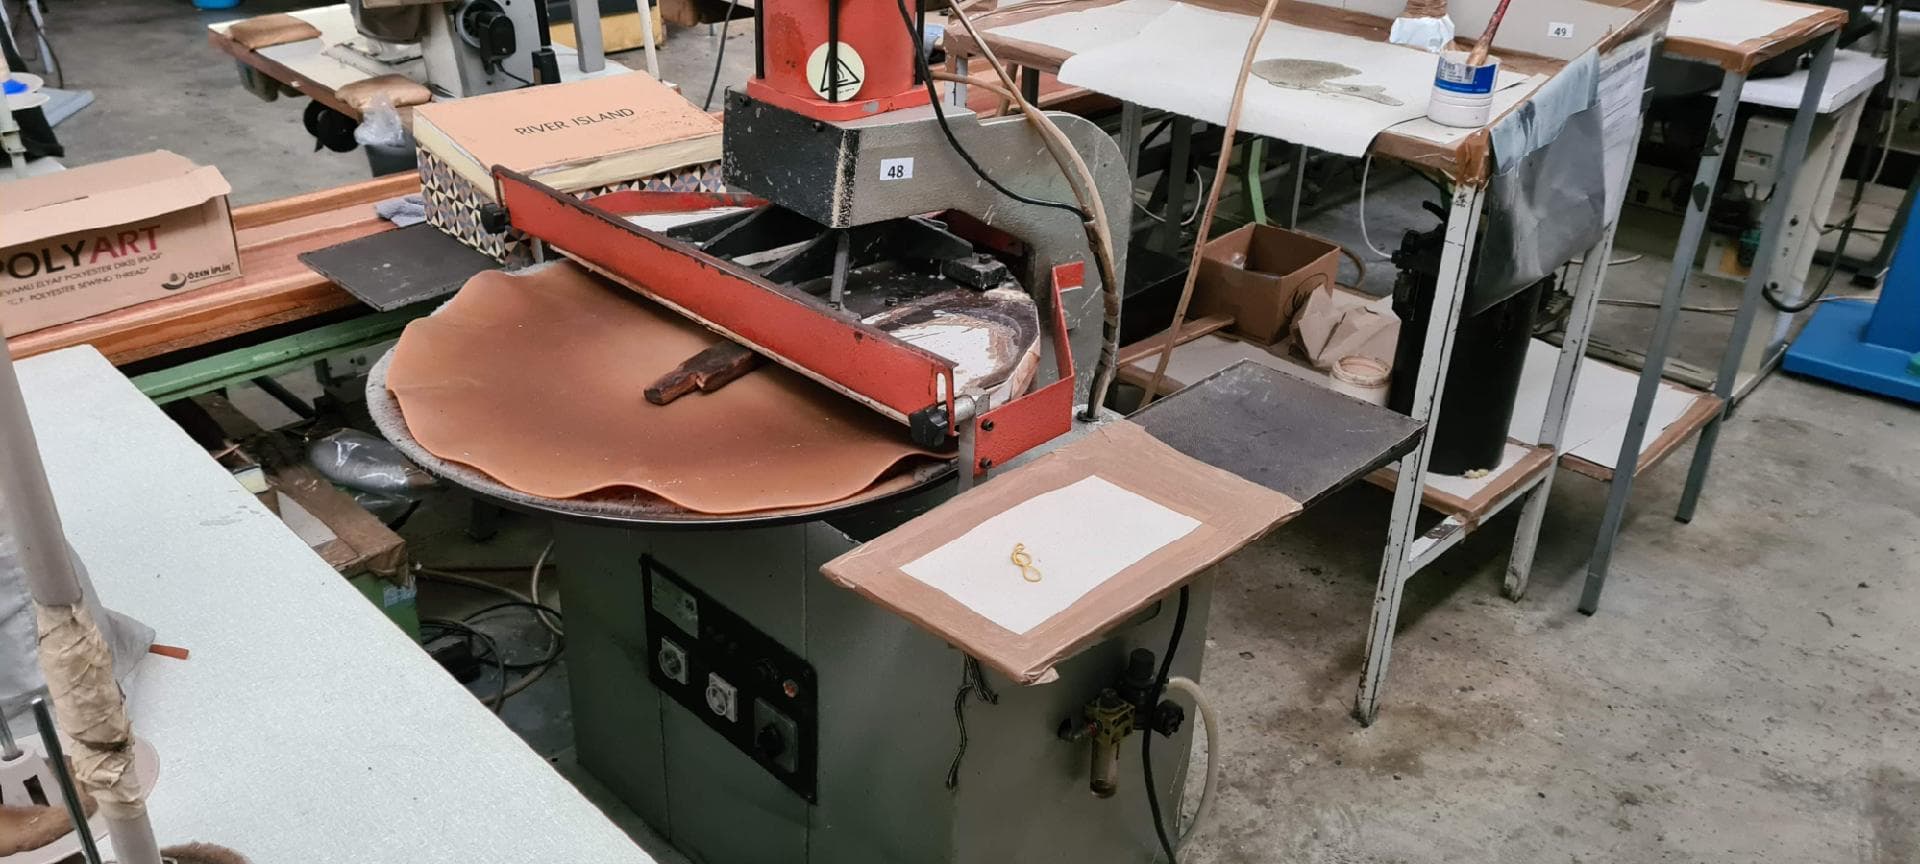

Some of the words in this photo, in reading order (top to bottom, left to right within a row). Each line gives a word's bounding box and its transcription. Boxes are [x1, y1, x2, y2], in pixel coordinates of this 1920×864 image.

[1553, 27, 1567, 37] 49
[514, 120, 570, 136] RIVER
[571, 108, 635, 127] ISLAND
[887, 164, 904, 178] 48
[0, 224, 161, 279] OLYART
